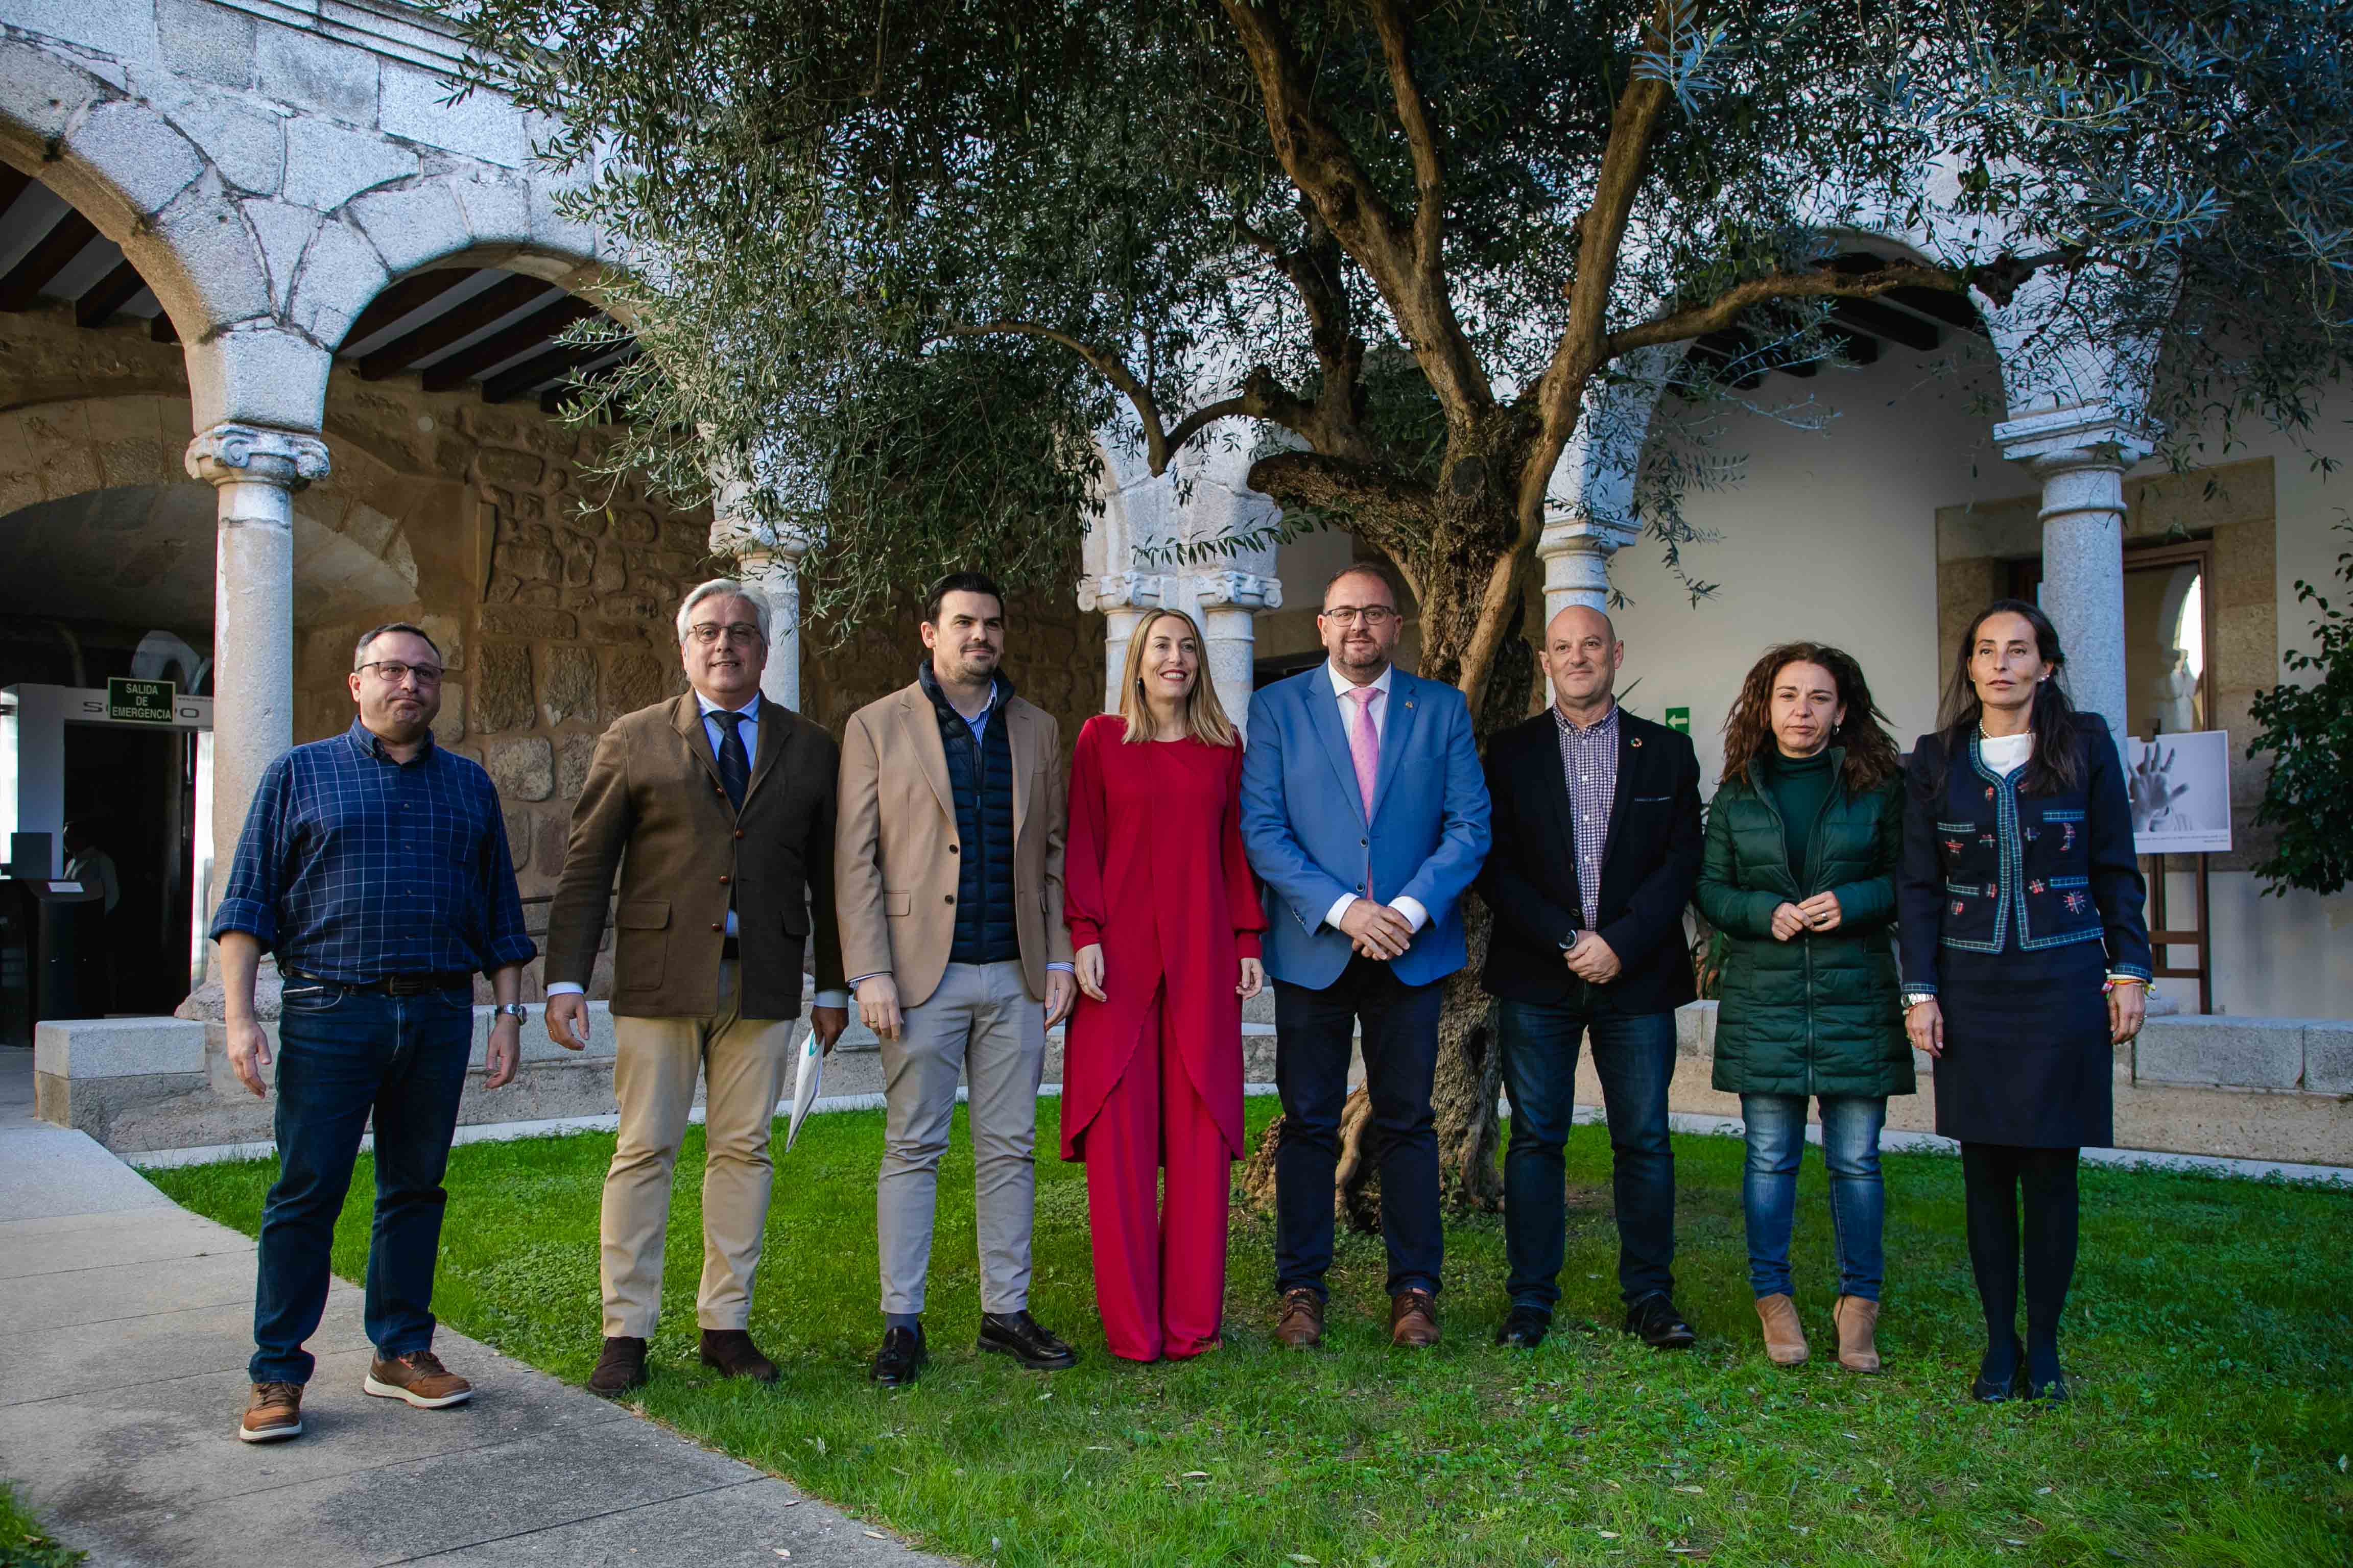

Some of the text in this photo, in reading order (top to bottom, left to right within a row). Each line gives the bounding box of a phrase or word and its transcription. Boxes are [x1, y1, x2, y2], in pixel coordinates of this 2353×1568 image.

[126, 683, 158, 695] SALIDA
[136, 696, 149, 707] DE
[112, 707, 172, 719] EMERGENCIA
